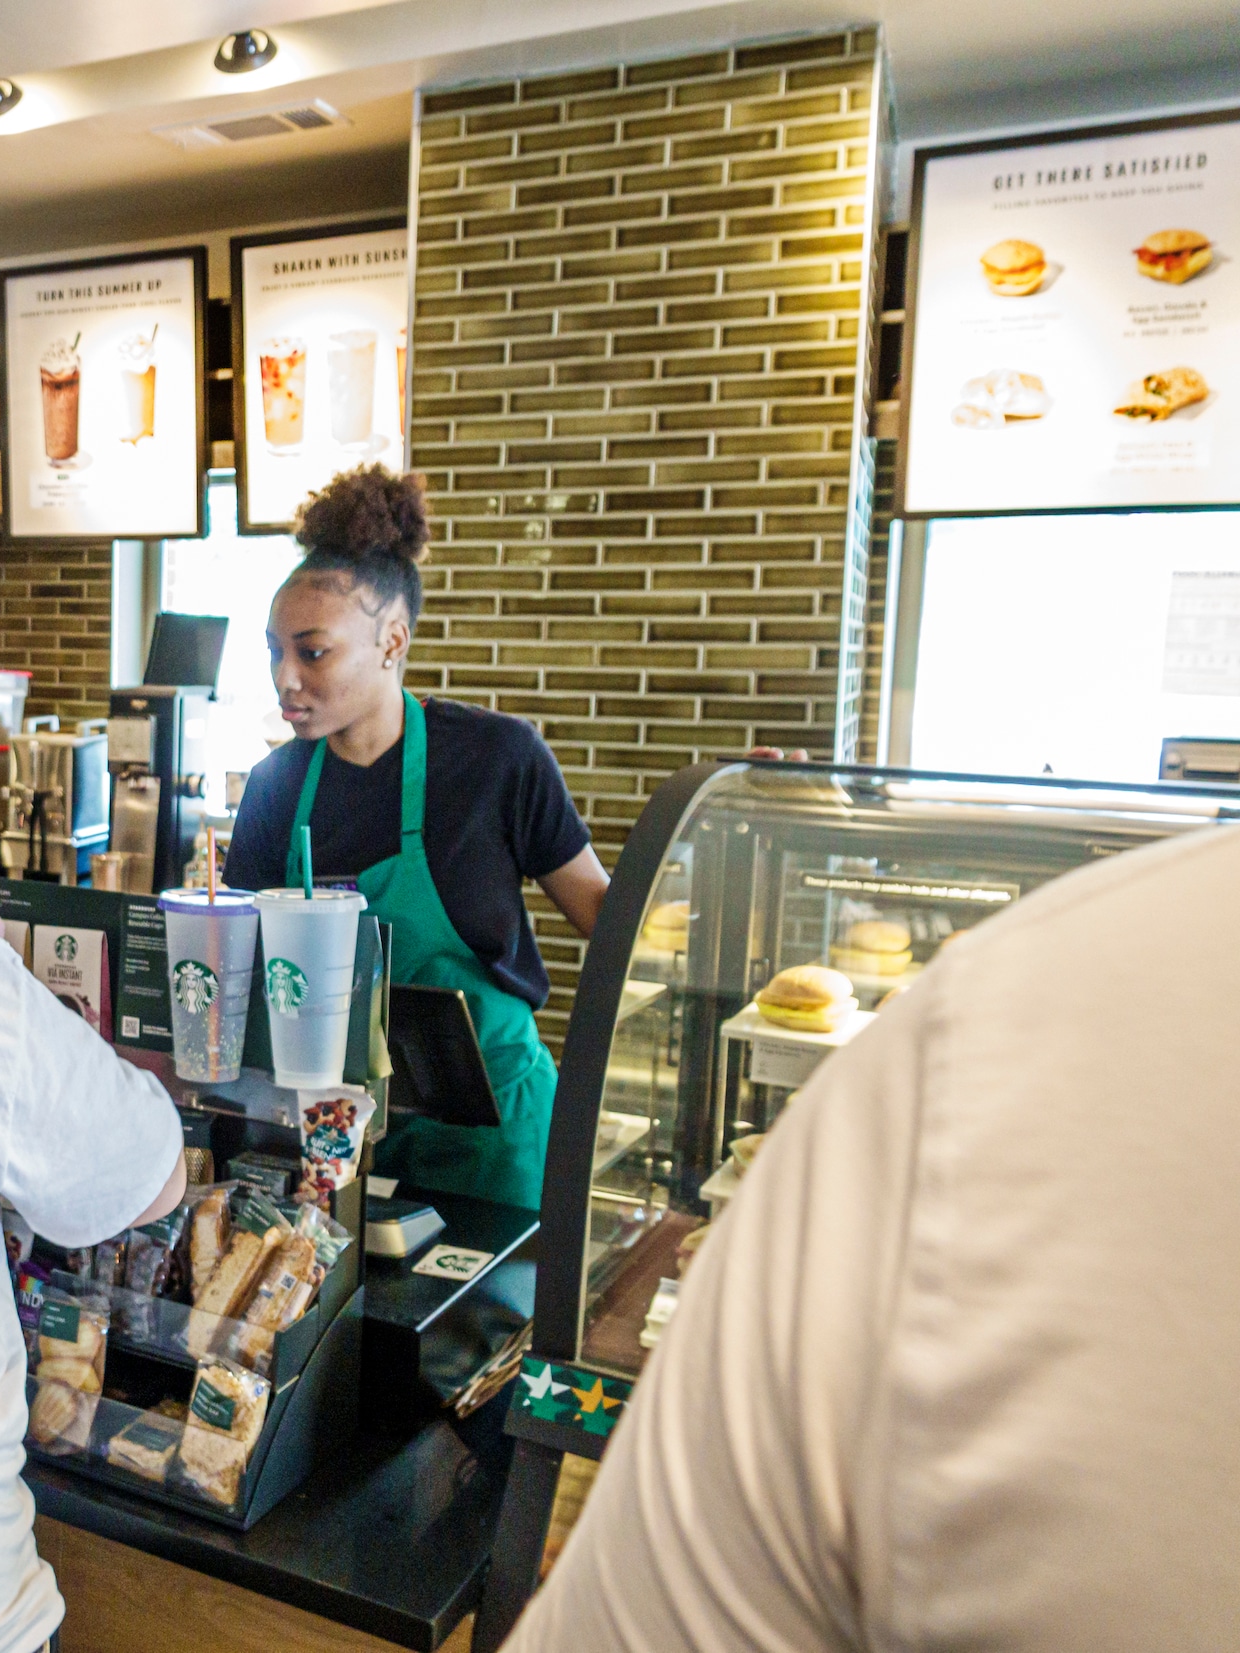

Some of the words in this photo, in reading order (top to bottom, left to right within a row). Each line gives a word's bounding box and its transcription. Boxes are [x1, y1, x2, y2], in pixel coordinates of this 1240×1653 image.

[993, 173, 1025, 191] GET
[1036, 165, 1093, 187] THERE
[1104, 153, 1208, 181] SATISFIED
[273, 258, 322, 275] SHAKEN
[328, 253, 360, 267] WITH
[366, 248, 408, 264] SUNSH
[36, 289, 65, 302] TURN
[69, 286, 93, 300] THIS
[98, 281, 143, 297] SUMMER
[148, 279, 162, 291] UP
[828, 878, 863, 890] products
[863, 881, 880, 893] may
[880, 883, 911, 895] contain
[930, 886, 948, 897] and
[948, 888, 970, 899] other
[59, 968, 83, 981] INSTANT
[21, 1292, 44, 1308] ND
